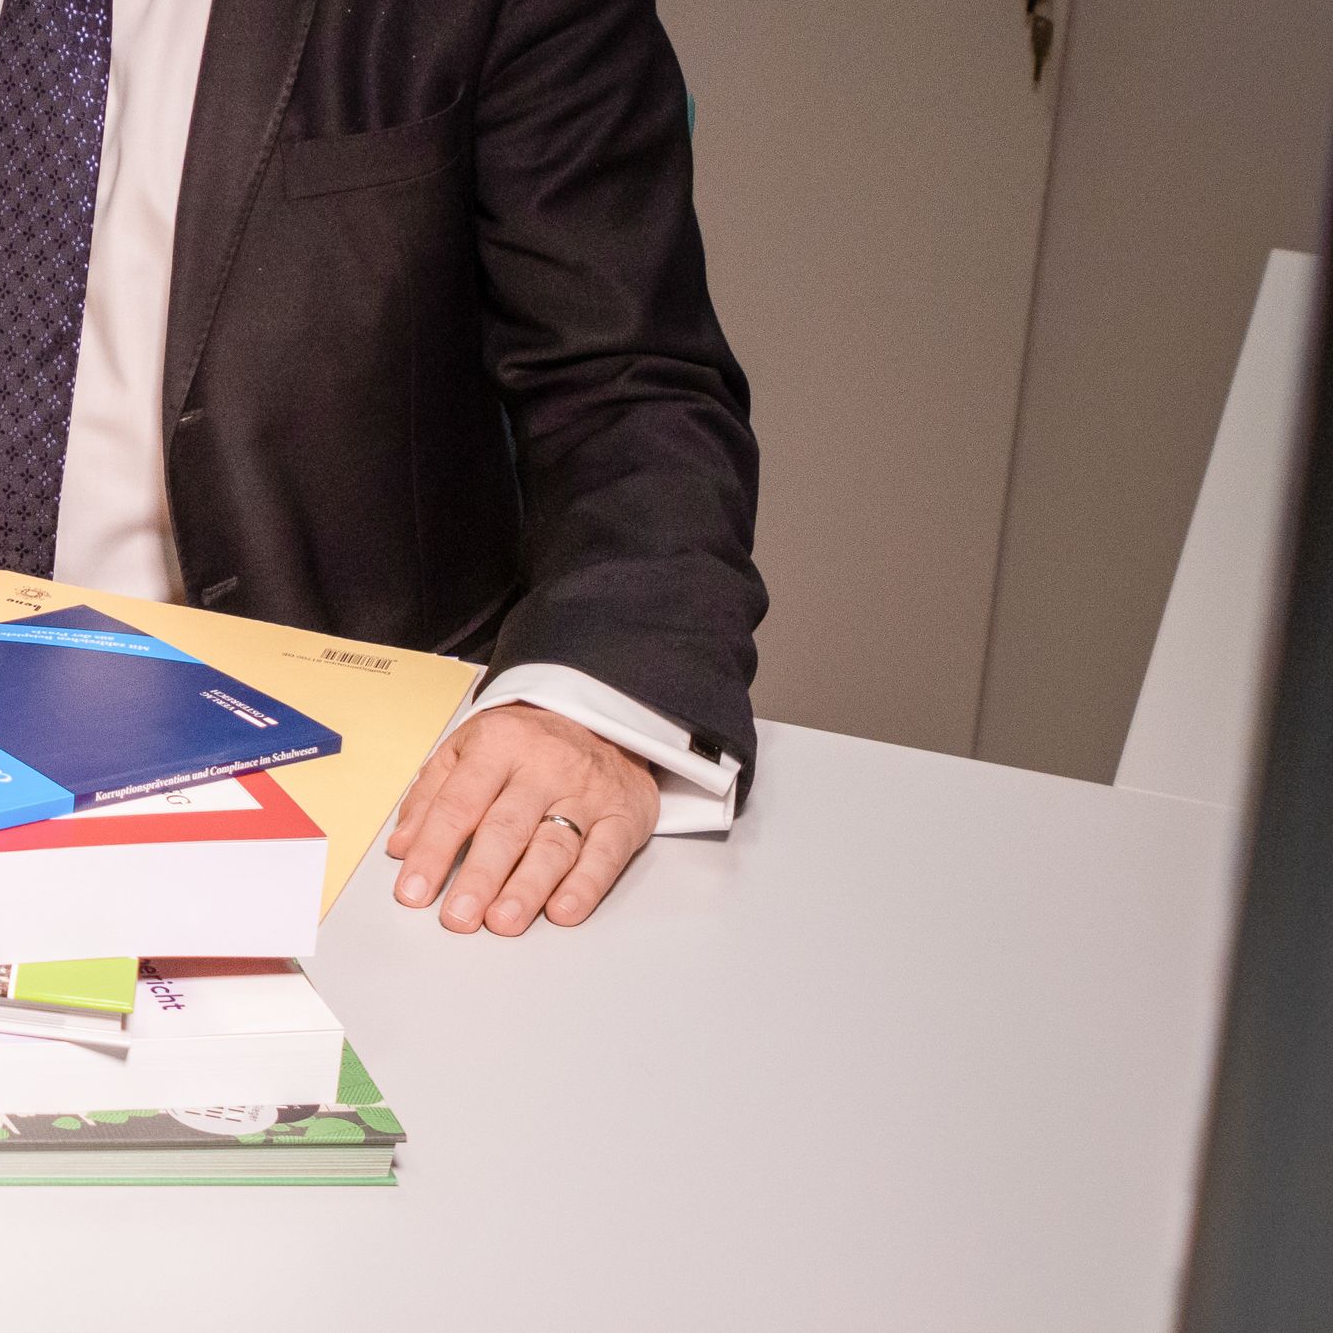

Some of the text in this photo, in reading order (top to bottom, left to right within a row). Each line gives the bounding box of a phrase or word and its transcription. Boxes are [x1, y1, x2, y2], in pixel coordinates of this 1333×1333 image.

[6, 598, 42, 612] bene
[56, 636, 126, 649] zahlreichen
[129, 644, 150, 652] Mit
[199, 691, 235, 711] VERLAG
[95, 773, 191, 802] Korruptionsprävention
[192, 768, 208, 780] und
[209, 758, 259, 776] Compliance
[259, 755, 271, 766] im
[272, 745, 318, 763] Schulwesen
